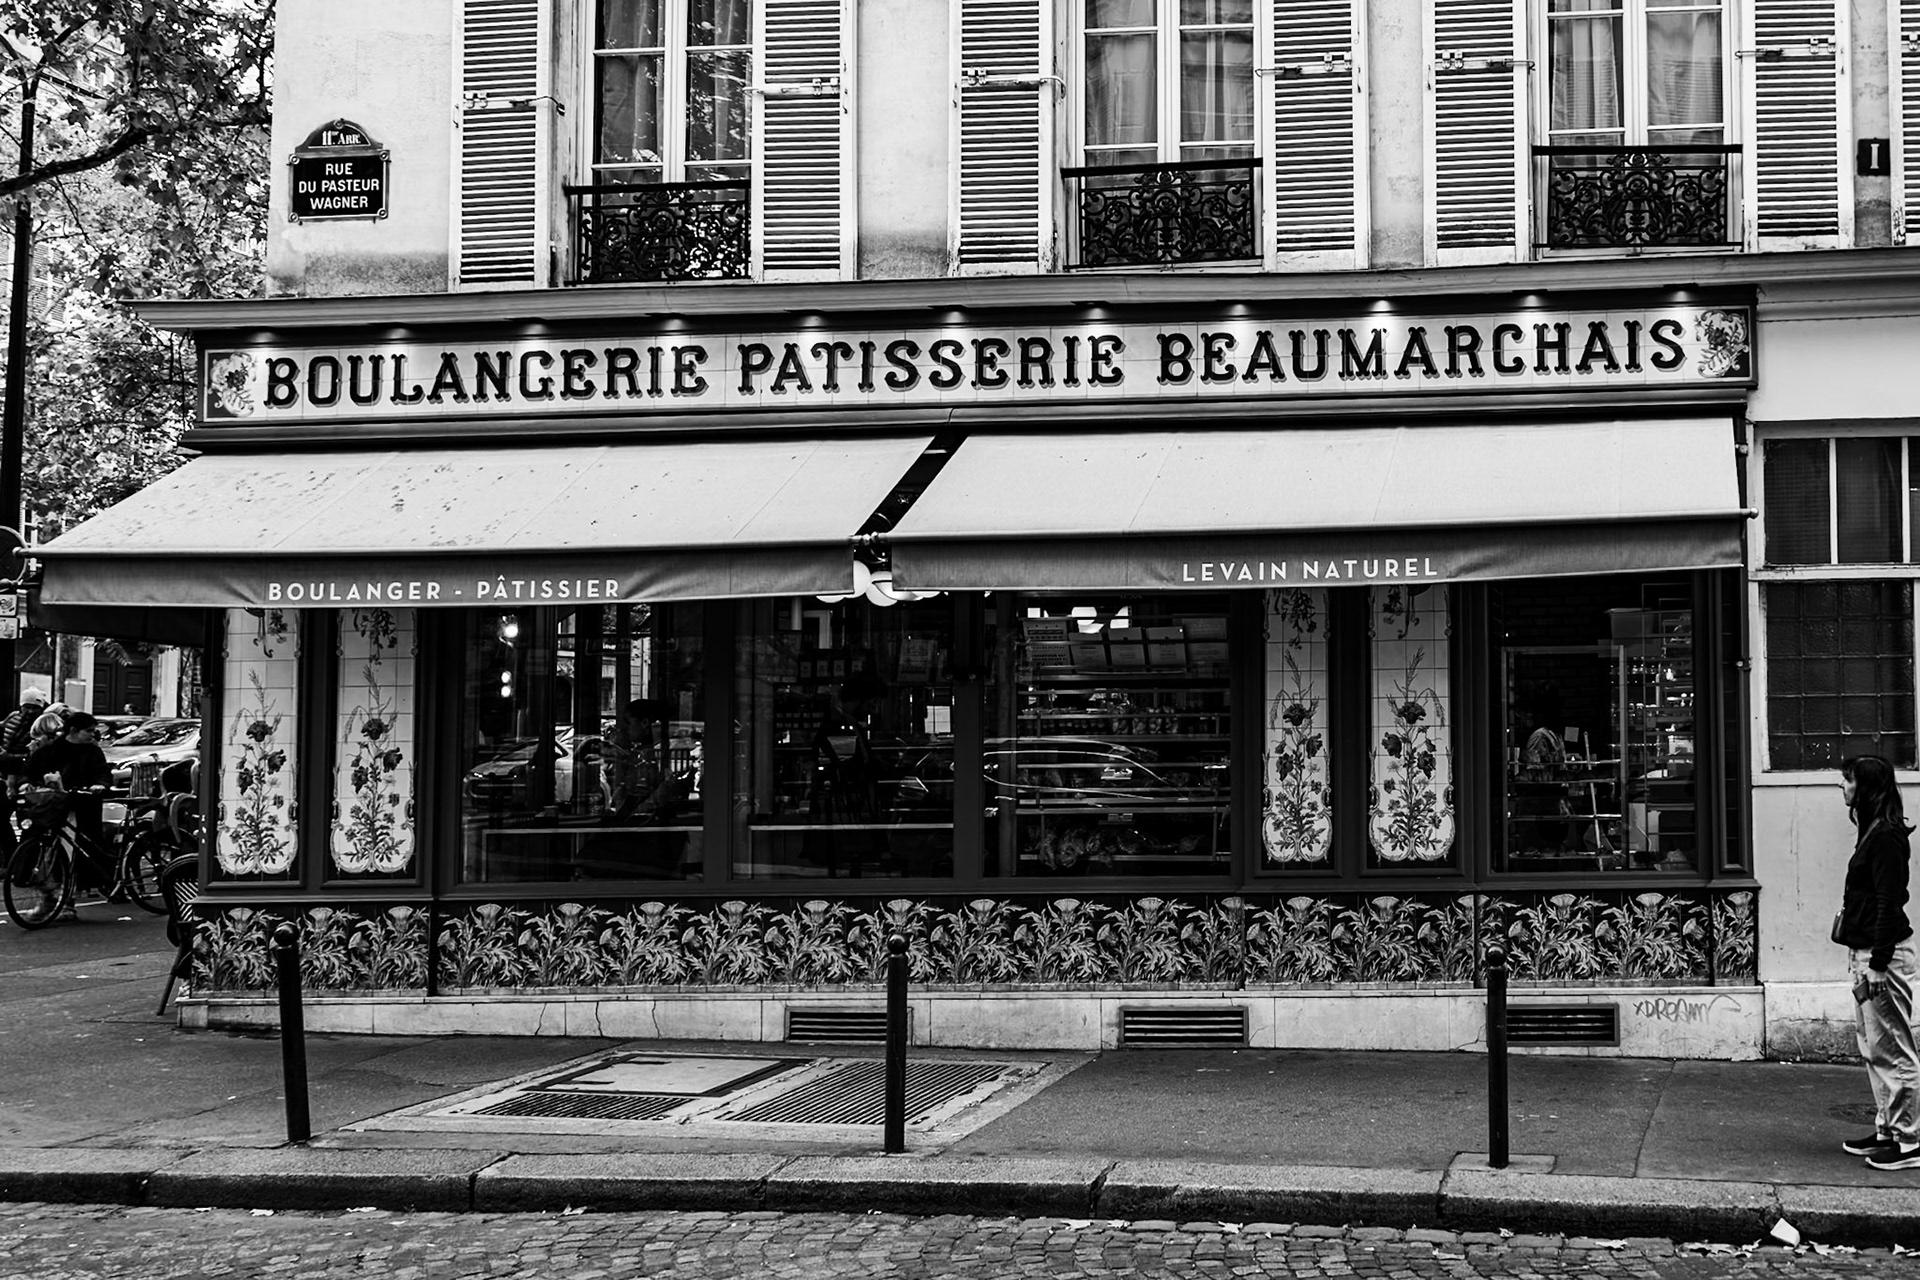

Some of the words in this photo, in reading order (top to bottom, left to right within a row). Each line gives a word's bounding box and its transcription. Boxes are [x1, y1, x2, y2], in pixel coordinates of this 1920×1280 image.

[325, 162, 353, 175] RUE
[298, 180, 317, 193] DU
[321, 178, 380, 193] PASTEUR
[310, 196, 368, 210] WAGNER
[264, 345, 710, 409] BOULANGERIE
[737, 335, 1126, 397] PATISSERIE
[1156, 319, 1688, 386] BEAUMARCHAIS
[1183, 562, 1287, 581] LEVAIN
[1303, 557, 1438, 579] NATUREL
[268, 581, 441, 601] BOULANGER
[477, 574, 619, 599] PÂTISSIER
